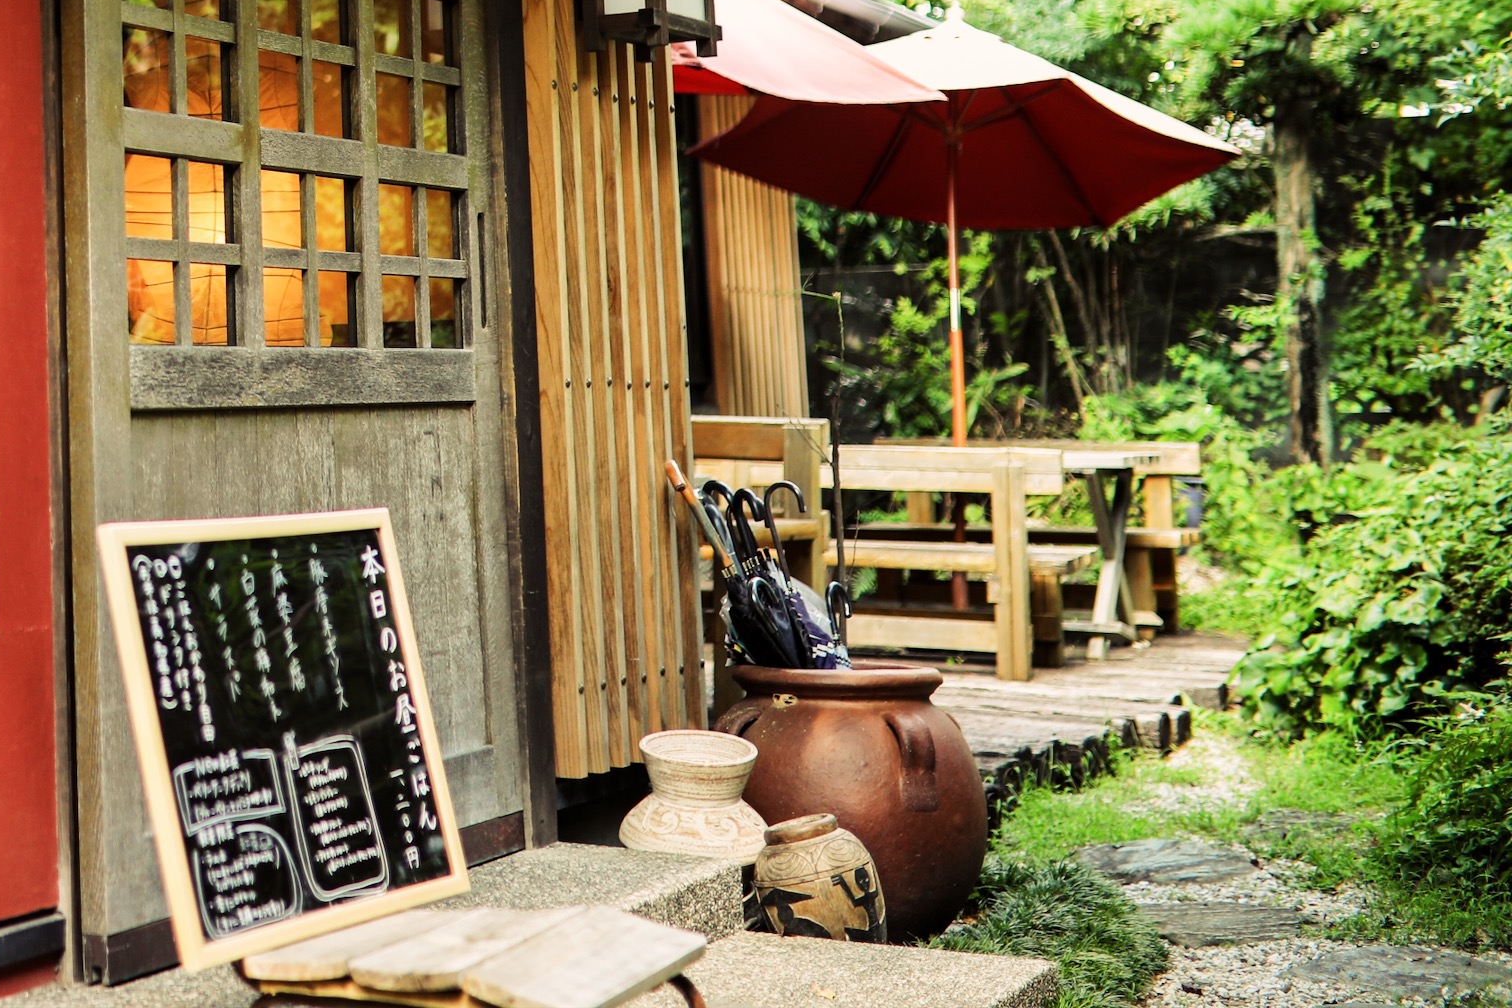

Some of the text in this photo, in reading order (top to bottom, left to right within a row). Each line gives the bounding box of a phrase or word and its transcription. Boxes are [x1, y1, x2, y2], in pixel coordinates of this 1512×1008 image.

[360, 544, 437, 832] 本日のお昼ごはん
